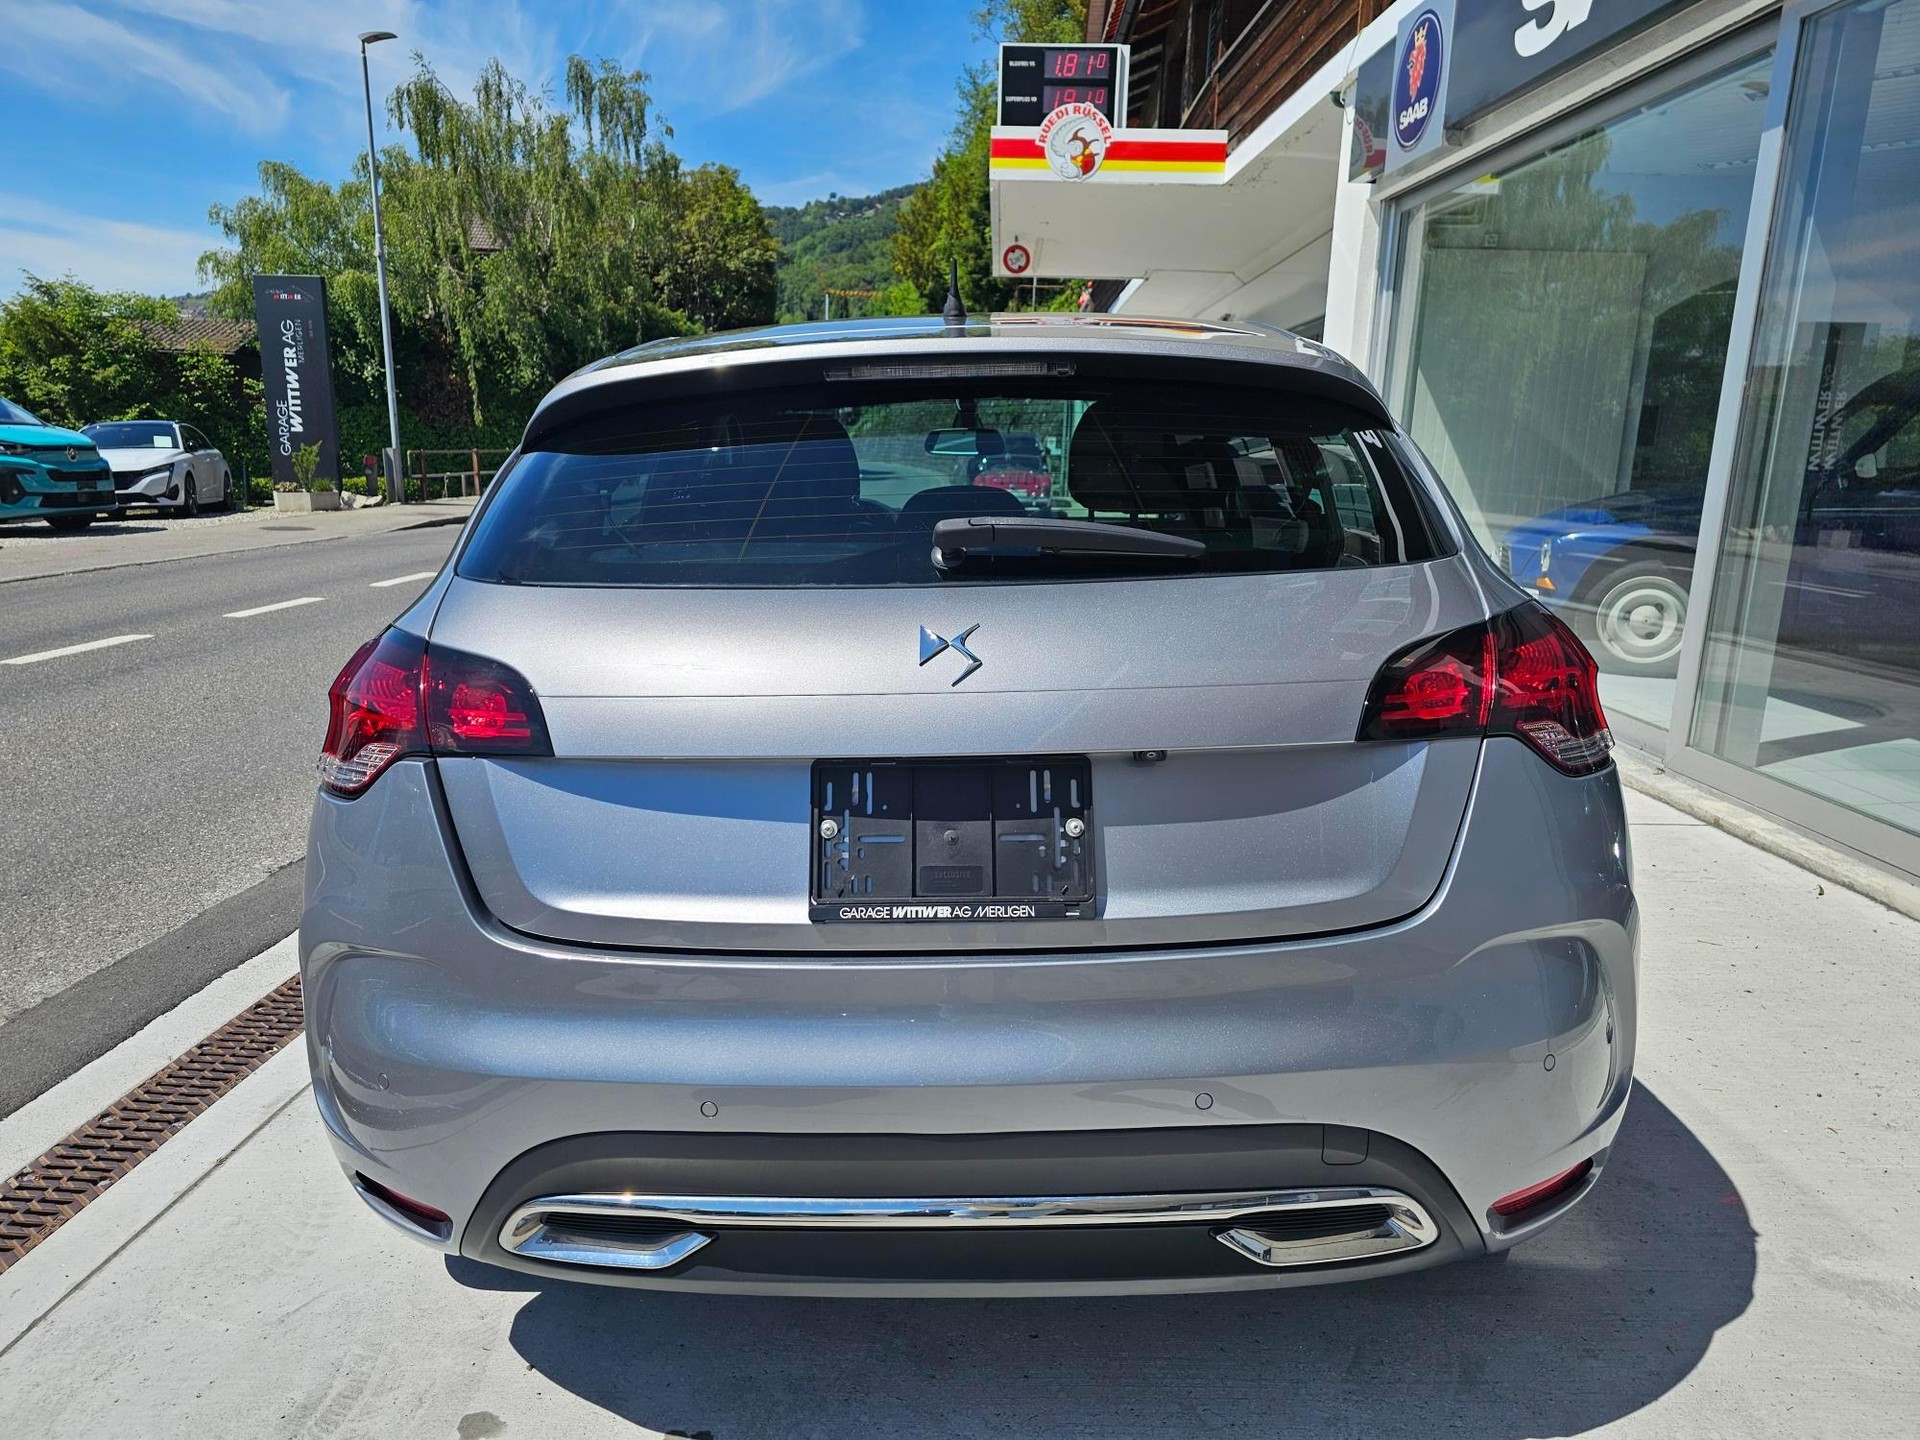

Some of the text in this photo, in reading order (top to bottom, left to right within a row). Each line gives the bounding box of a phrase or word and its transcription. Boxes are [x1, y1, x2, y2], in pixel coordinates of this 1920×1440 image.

[1039, 103, 1113, 143] RUEDI RÜSSEL
[1399, 97, 1429, 130] SAAB
[280, 319, 304, 433] WITTWER AG
[276, 399, 292, 456] GARAGE
[839, 905, 1036, 919] GARAGE WITTWER AG MERLIGEN
